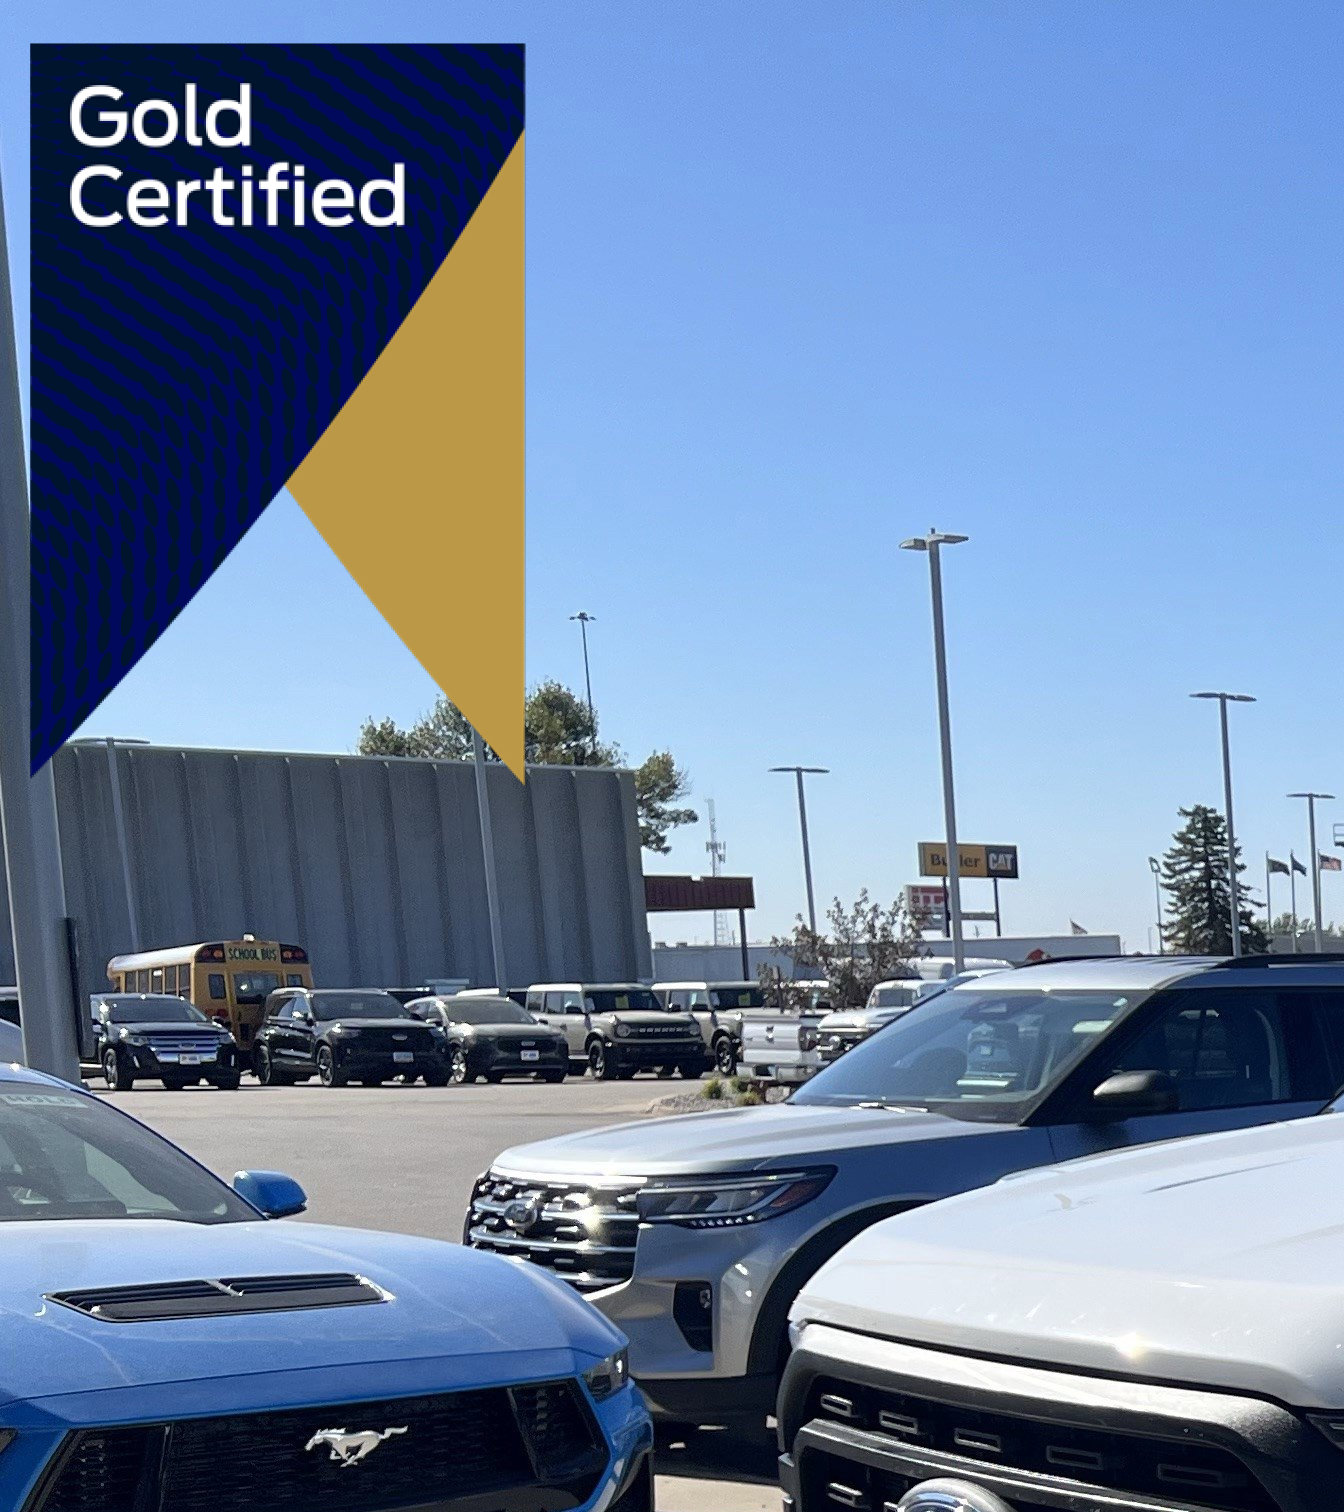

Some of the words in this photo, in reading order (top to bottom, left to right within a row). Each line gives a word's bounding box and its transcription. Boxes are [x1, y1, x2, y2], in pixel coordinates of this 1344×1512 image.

[930, 853, 980, 867] Buler
[988, 853, 1013, 871] CAT
[228, 948, 258, 960] SCHOOL
[261, 948, 277, 961] BUS
